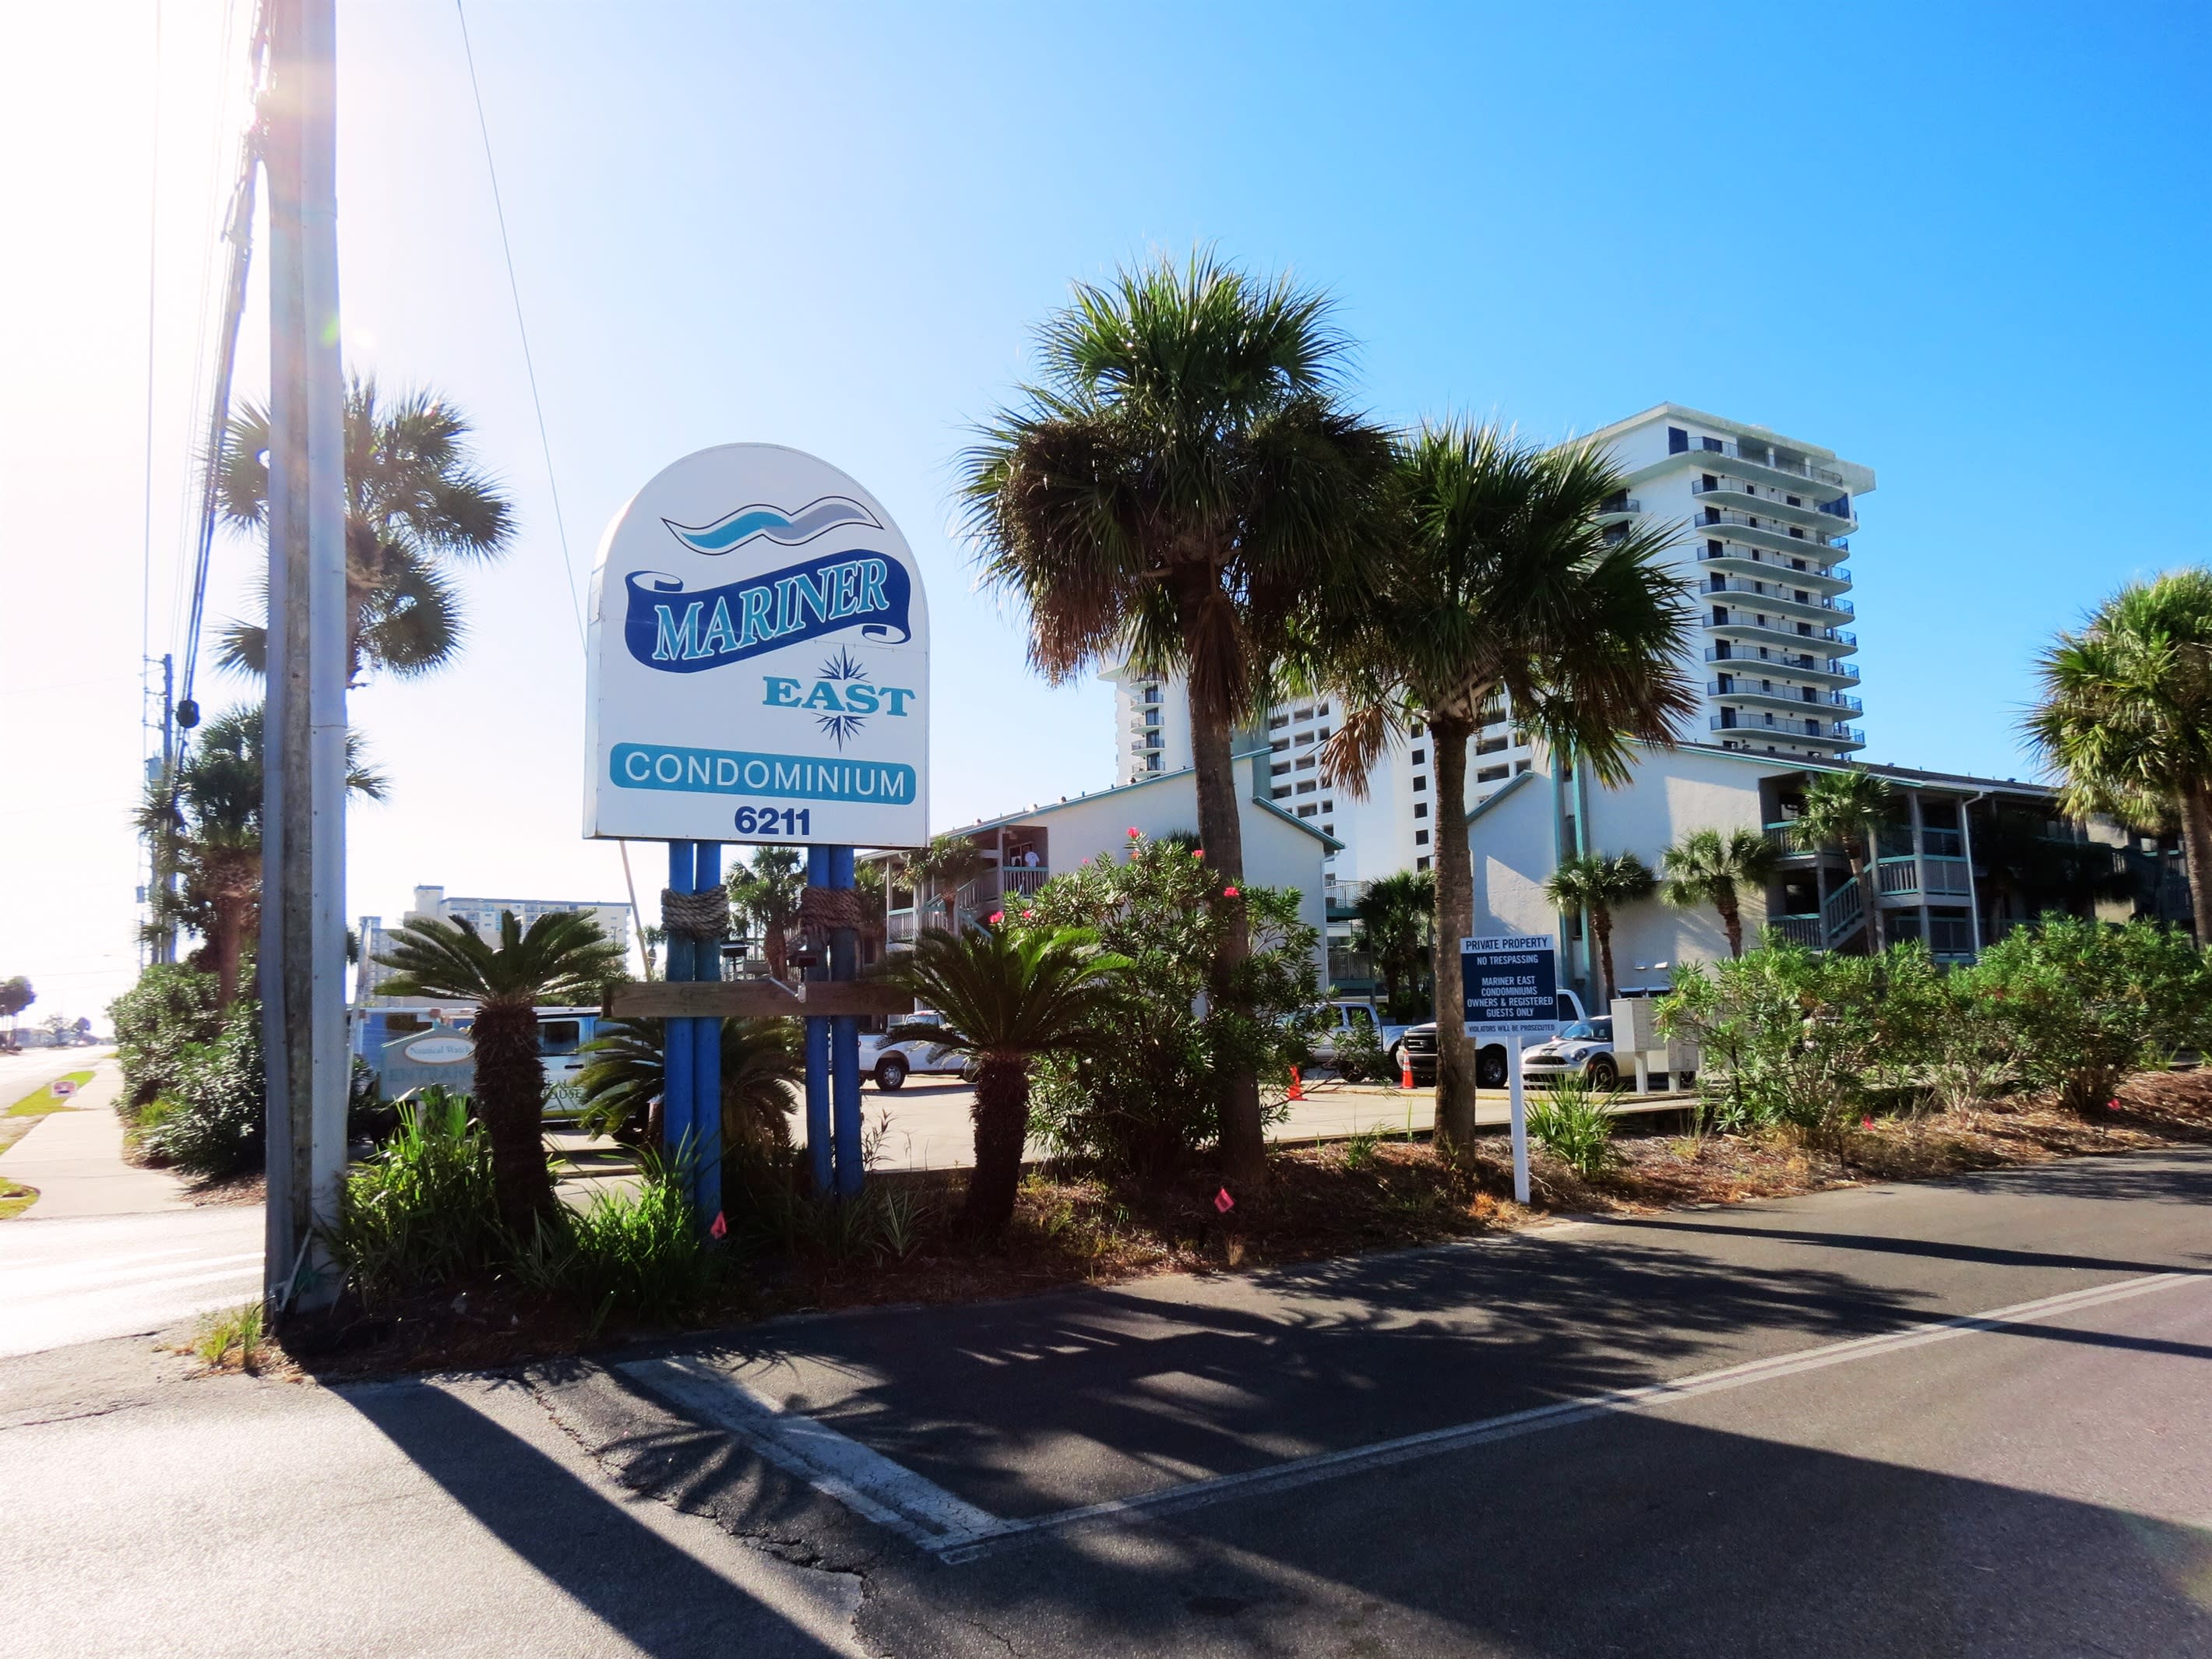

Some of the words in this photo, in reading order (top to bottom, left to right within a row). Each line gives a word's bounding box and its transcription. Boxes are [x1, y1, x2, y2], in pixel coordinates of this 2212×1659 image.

[651, 558, 890, 661] MARINER
[762, 675, 916, 717] EAST
[625, 751, 905, 798] CONDOMINIUM
[734, 805, 810, 836] 6211
[1466, 939, 1499, 950] PRIVATE
[1502, 937, 1548, 949] PROPERTY
[1477, 956, 1488, 965] NO
[1489, 954, 1538, 965] TRESPASSING
[1481, 977, 1515, 986] MARINER
[1516, 976, 1535, 985] EAST
[1481, 986, 1537, 997] CONDOMINIUMS
[1467, 999, 1499, 1007] OWNERS
[1501, 998, 1506, 1006] &
[1509, 997, 1553, 1006] REGISTERED
[1486, 1008, 1514, 1017] GUESTS
[1516, 1008, 1534, 1016] ONLY
